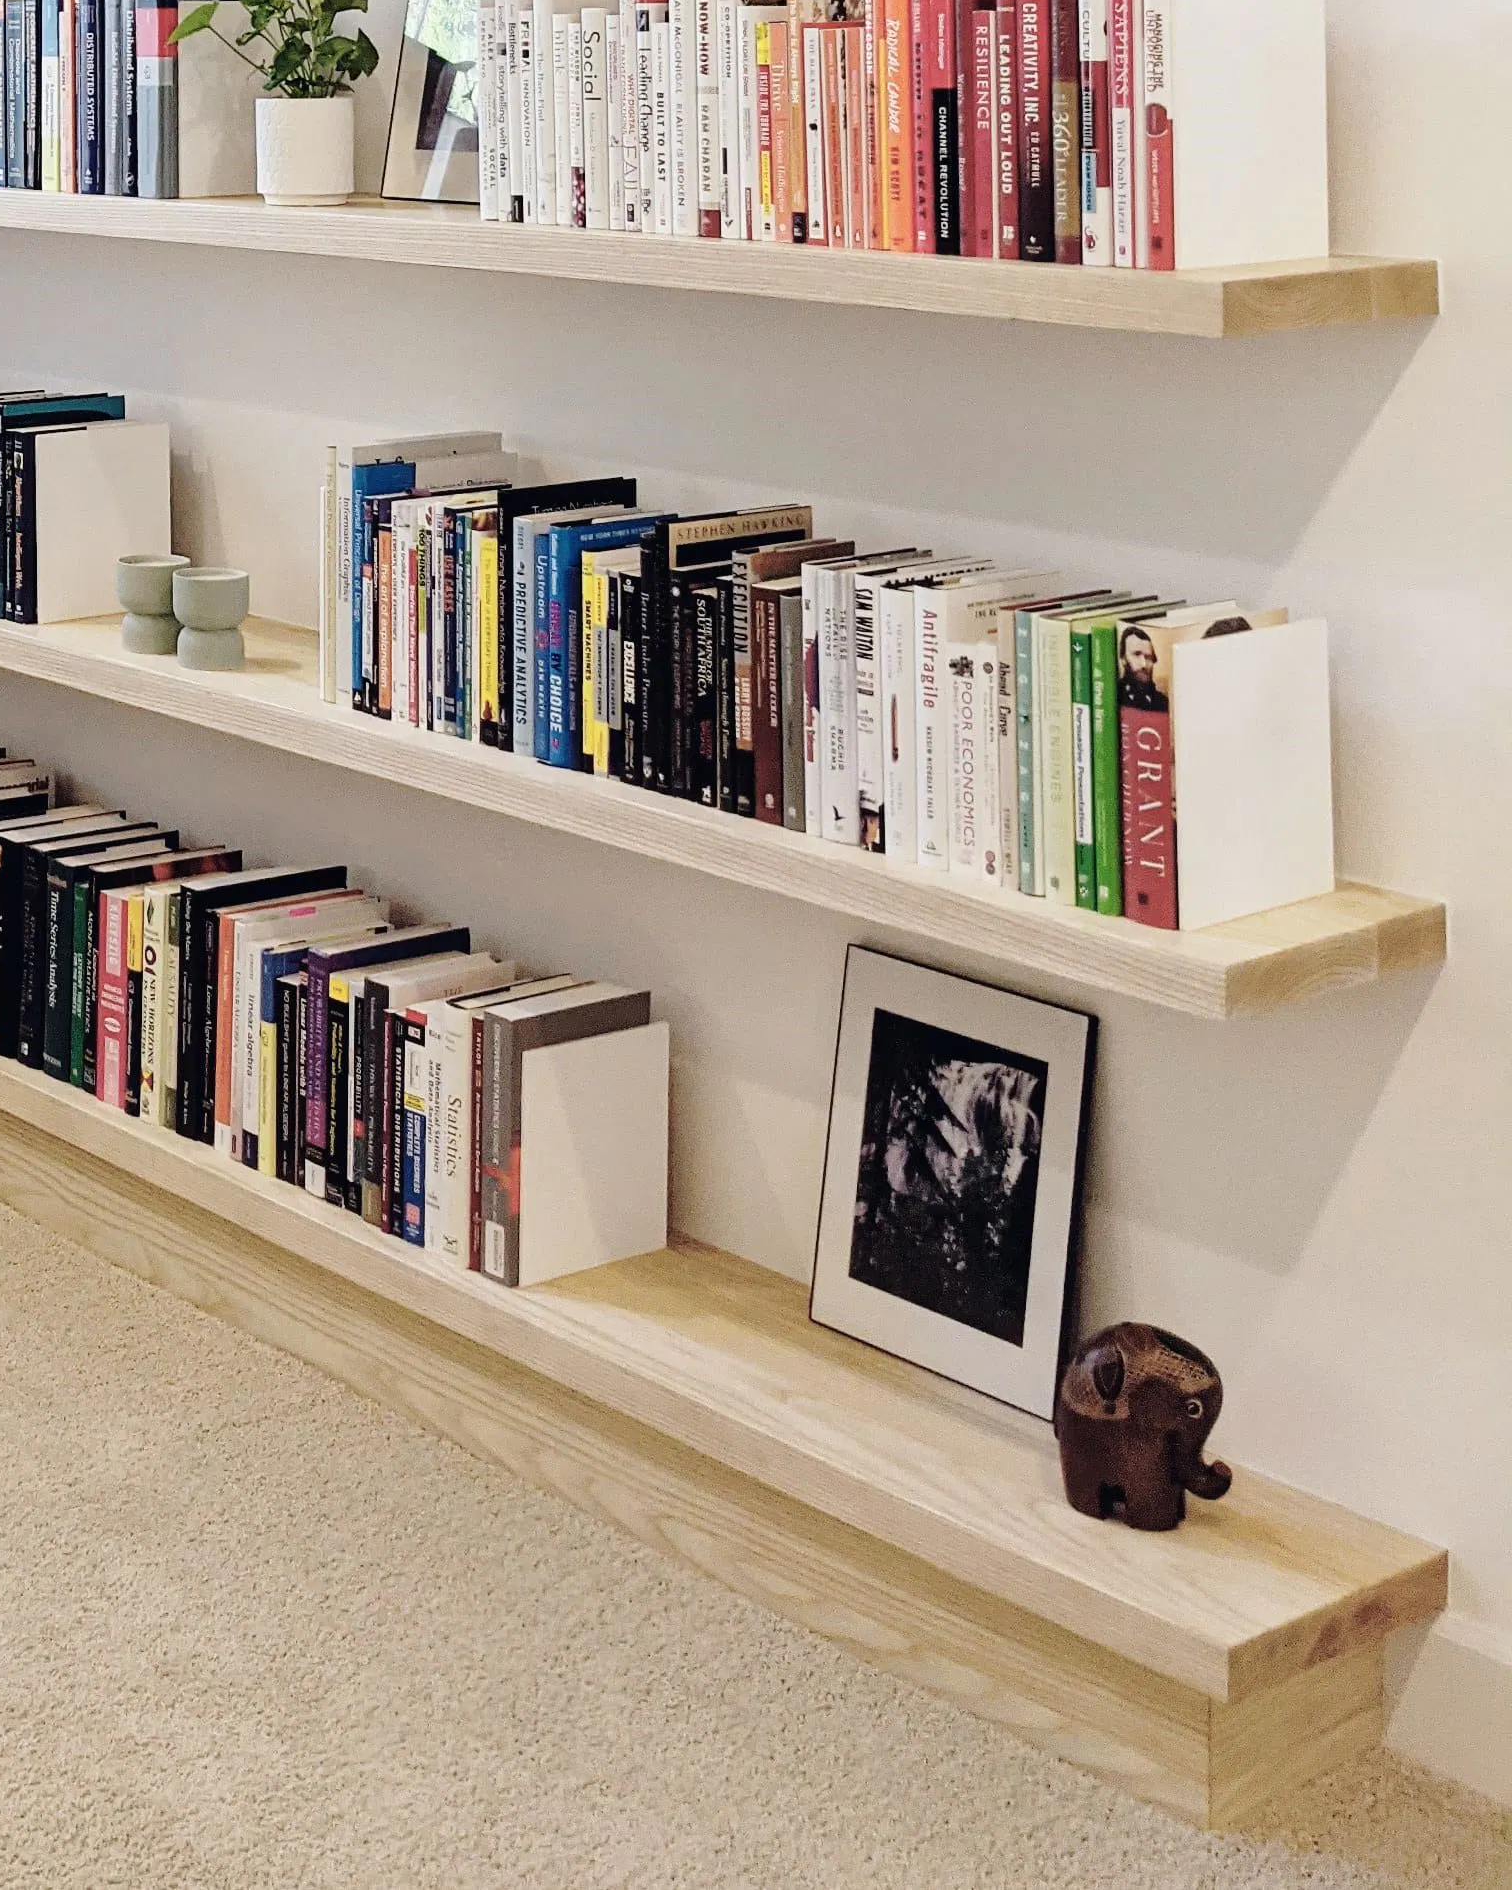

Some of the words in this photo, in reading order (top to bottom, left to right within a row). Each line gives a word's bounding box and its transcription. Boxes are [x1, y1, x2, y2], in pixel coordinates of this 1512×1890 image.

[86, 32, 95, 95] DISTRIBUTED
[125, 10, 134, 70] Distributed
[509, 22, 517, 75] Bottlenecks
[886, 18, 900, 77] RADICAL
[1022, 3, 1039, 93] CREATIVITY,
[1115, 2, 1128, 95] SAPIENS
[1154, 13, 1164, 68] MANAGING
[582, 30, 602, 102] Social
[627, 73, 635, 96] WHY
[638, 48, 652, 101] Leading
[771, 62, 786, 111] Thrive
[975, 26, 989, 130] RESILIENCE
[999, 34, 1011, 105] LEADING
[125, 72, 134, 116] Systems
[496, 65, 507, 123] storytelling
[523, 79, 531, 147] INNOVATION
[628, 99, 636, 134] DIGITAL
[656, 92, 665, 126] BUILT
[887, 82, 901, 134] CANDOR
[1024, 96, 1039, 127] INC.
[87, 97, 95, 141] SYSTEMS
[499, 127, 508, 149] with
[639, 104, 653, 153] Change
[657, 132, 665, 147] TO
[676, 103, 684, 143] REALITY
[701, 105, 711, 133] RAM
[938, 106, 948, 162] CHANNEL
[1000, 112, 1012, 146] OUT
[1030, 131, 1039, 143] ED
[1115, 119, 1127, 153] Yuval
[499, 152, 509, 178] data
[657, 152, 666, 182] LAST
[702, 138, 712, 192] CHARAN
[890, 147, 899, 166] KIM
[1001, 151, 1013, 194] LOUD
[1116, 156, 1127, 190] Noah
[677, 160, 685, 206] BROKEN
[939, 164, 949, 239] REVOLUTION
[1117, 193, 1128, 234] Harari
[418, 528, 426, 547] 100
[498, 543, 507, 577] Turning
[418, 548, 427, 587] THINGS
[536, 555, 548, 619] Upstream
[515, 582, 527, 654] PREDICTIVE
[584, 600, 592, 628] SMART
[640, 591, 651, 631] Better
[696, 598, 706, 640] SOUTH
[733, 562, 748, 655] EXECUTION
[855, 588, 873, 610] SAM
[584, 633, 592, 681] MACHINES
[856, 615, 874, 661] WALTON
[920, 609, 939, 709] Antifragile
[550, 653, 561, 672] BY
[624, 641, 635, 704] EXCELLENCE
[696, 643, 708, 697] AFRICA
[515, 657, 528, 725] ANALYTICS
[549, 674, 563, 733] CHOICE
[642, 678, 651, 731] Pressure
[960, 680, 974, 732] POOR
[961, 739, 976, 847] ECONOMICS
[1076, 766, 1087, 839] Presentations
[1136, 725, 1166, 878] GRANT
[50, 890, 59, 920] Time
[48, 921, 58, 960] Series
[85, 910, 94, 957] MODERN
[47, 961, 58, 1008] Analysis
[147, 977, 157, 1004] NEW
[146, 1008, 156, 1064] HORIZONS
[246, 994, 255, 1031] linear
[245, 1032, 255, 1077] algebra
[474, 1031, 482, 1065] TAYLOR
[354, 1055, 362, 1114] PROBABILITY
[394, 1047, 402, 1110] STATISTICAL
[433, 1062, 442, 1128] Mathematical
[393, 1113, 401, 1194] DISTRIBUTIONS
[433, 1129, 442, 1174] Statistics
[446, 1094, 463, 1178] Statistics
